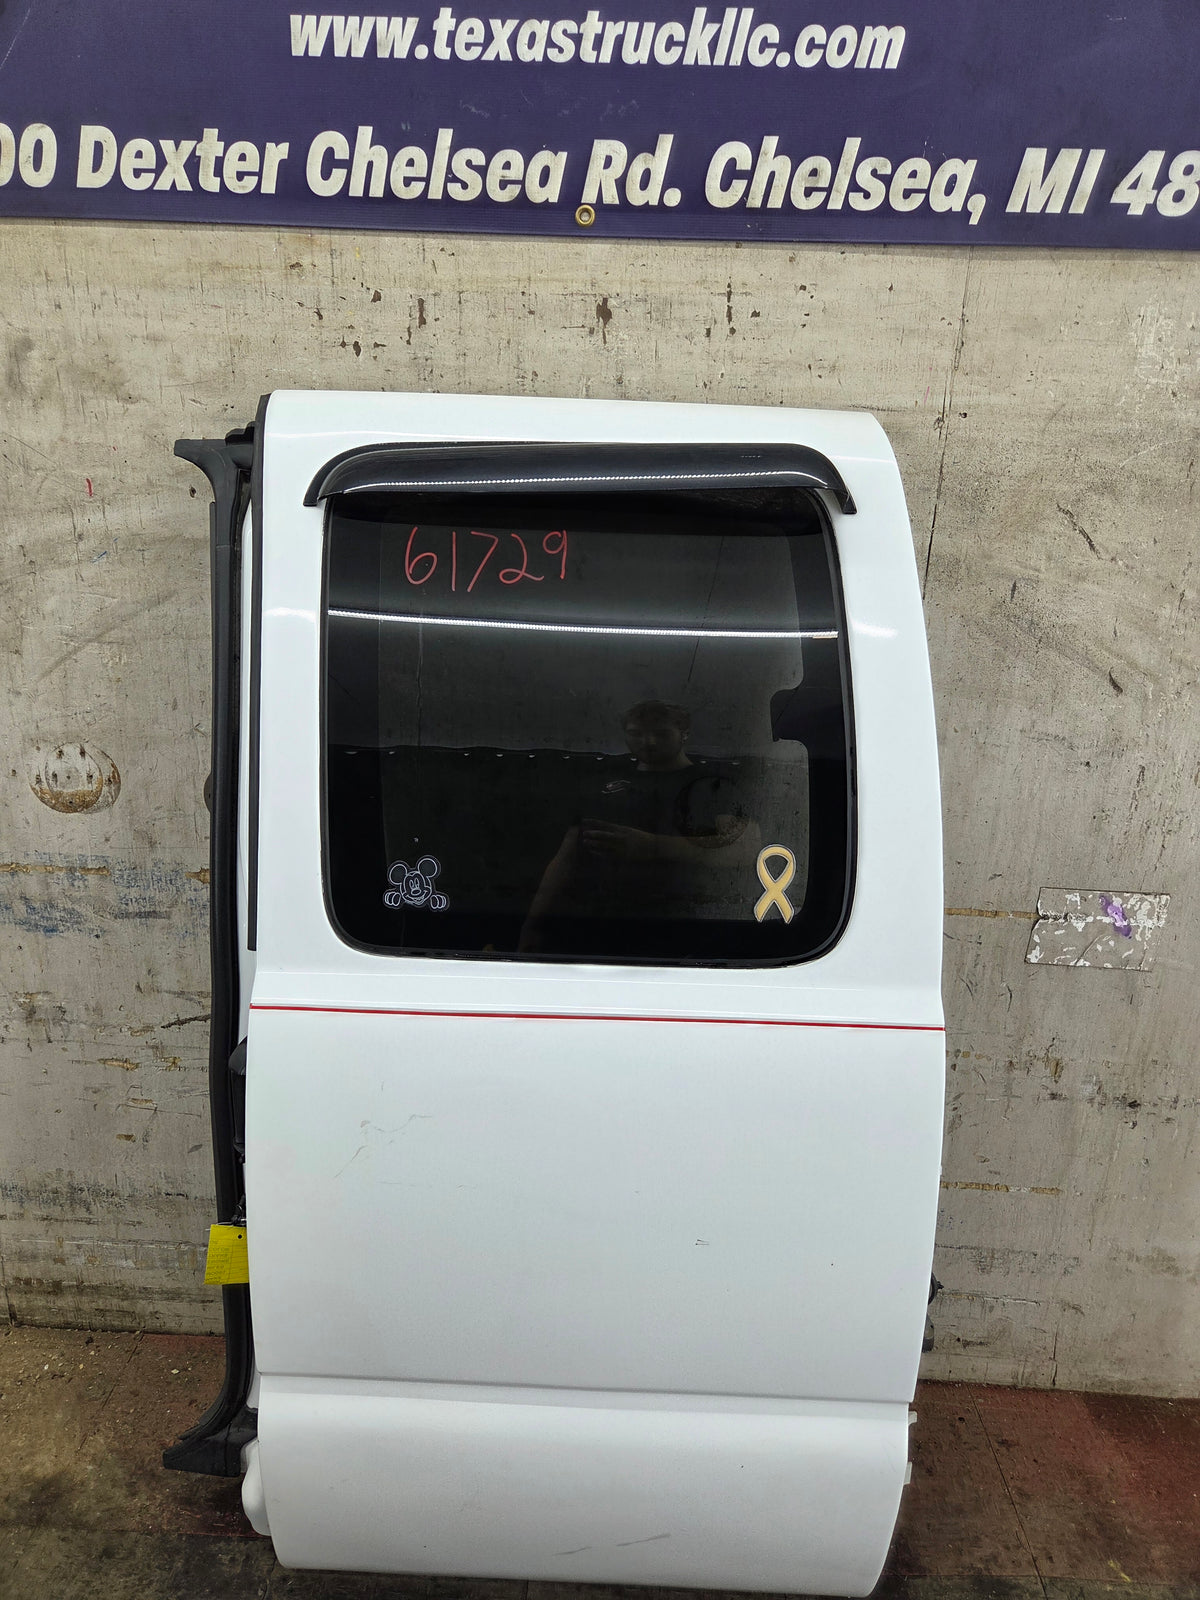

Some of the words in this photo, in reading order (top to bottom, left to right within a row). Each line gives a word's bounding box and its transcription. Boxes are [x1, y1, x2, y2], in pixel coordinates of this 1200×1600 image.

[289, 6, 907, 70] www.texastruckllc.com
[76, 124, 290, 194] Dexter
[306, 125, 568, 204] Chelsea
[580, 133, 682, 207] Rd.
[704, 135, 987, 226] Chelsea,
[1005, 147, 1106, 215] MI
[1109, 150, 1200, 217] 48
[405, 526, 568, 592] 61729
